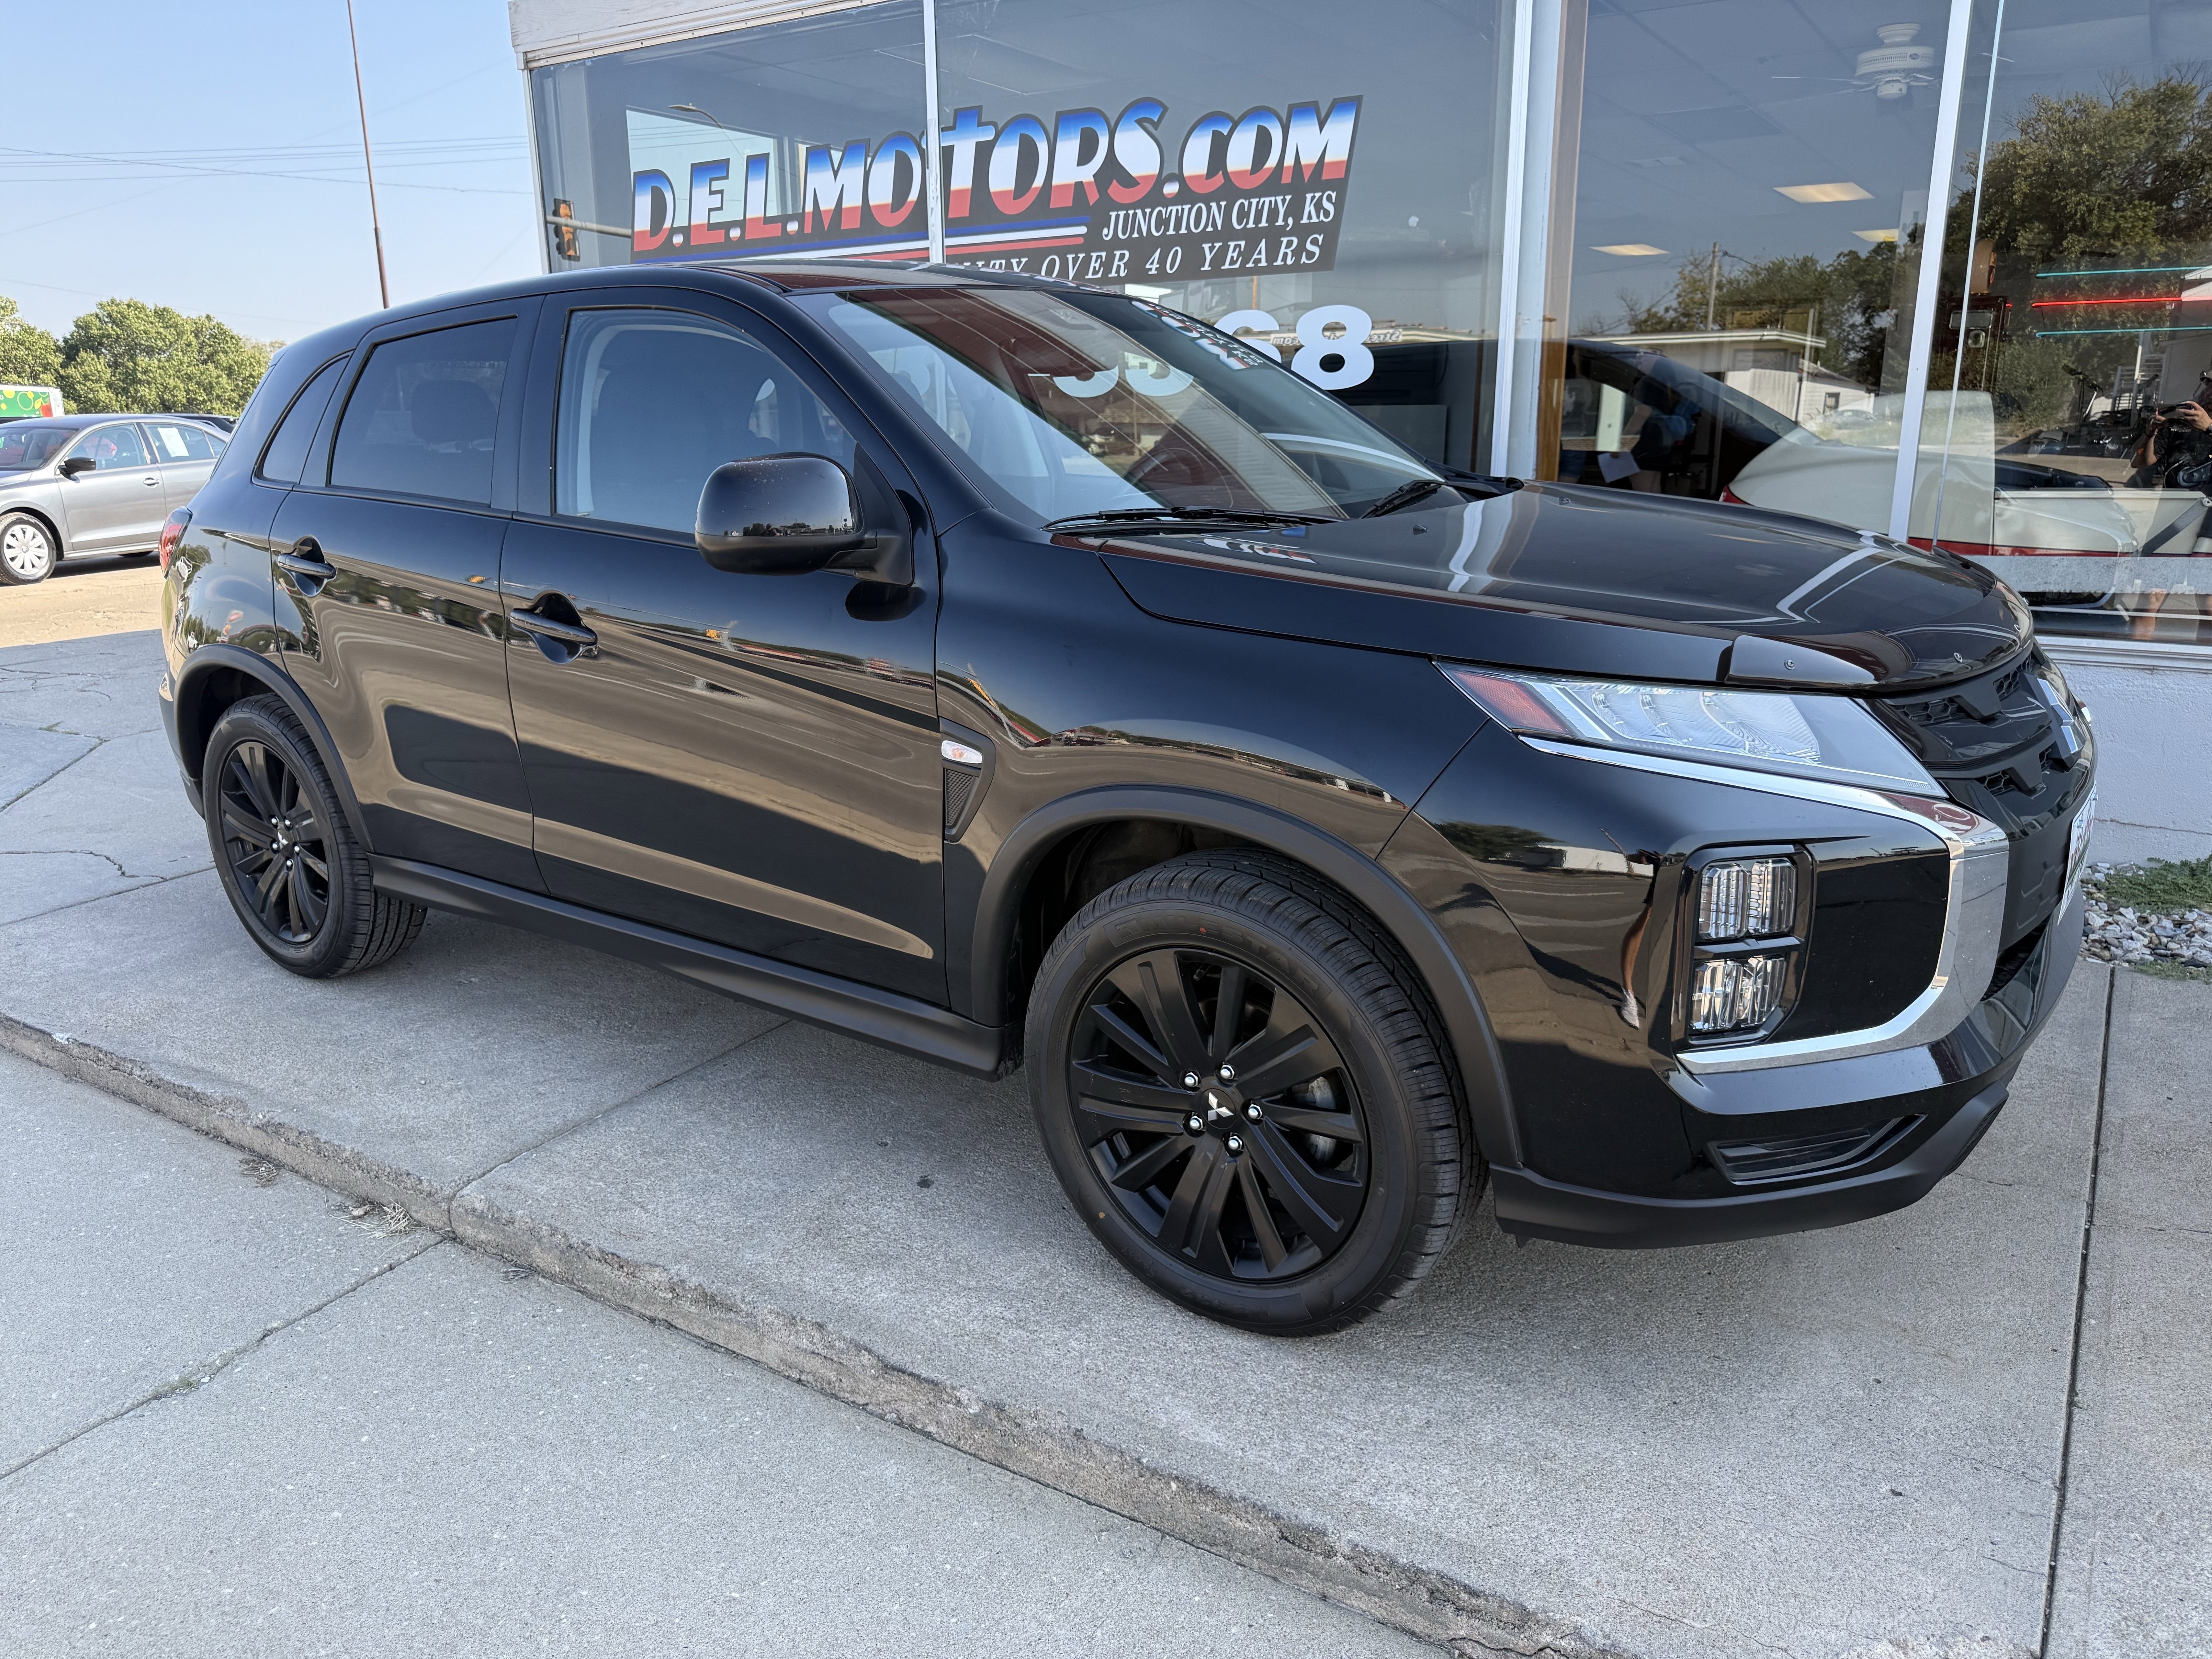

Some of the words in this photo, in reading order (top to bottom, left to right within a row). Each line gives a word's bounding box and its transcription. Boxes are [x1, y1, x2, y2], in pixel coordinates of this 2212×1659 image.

[1103, 201, 1226, 240] JUNCTION
[1231, 196, 1294, 232] CITY,
[1301, 190, 1337, 223] KS
[1041, 251, 1130, 280] OVER
[1145, 246, 1182, 275] 40
[1200, 234, 1324, 271] YEARS
